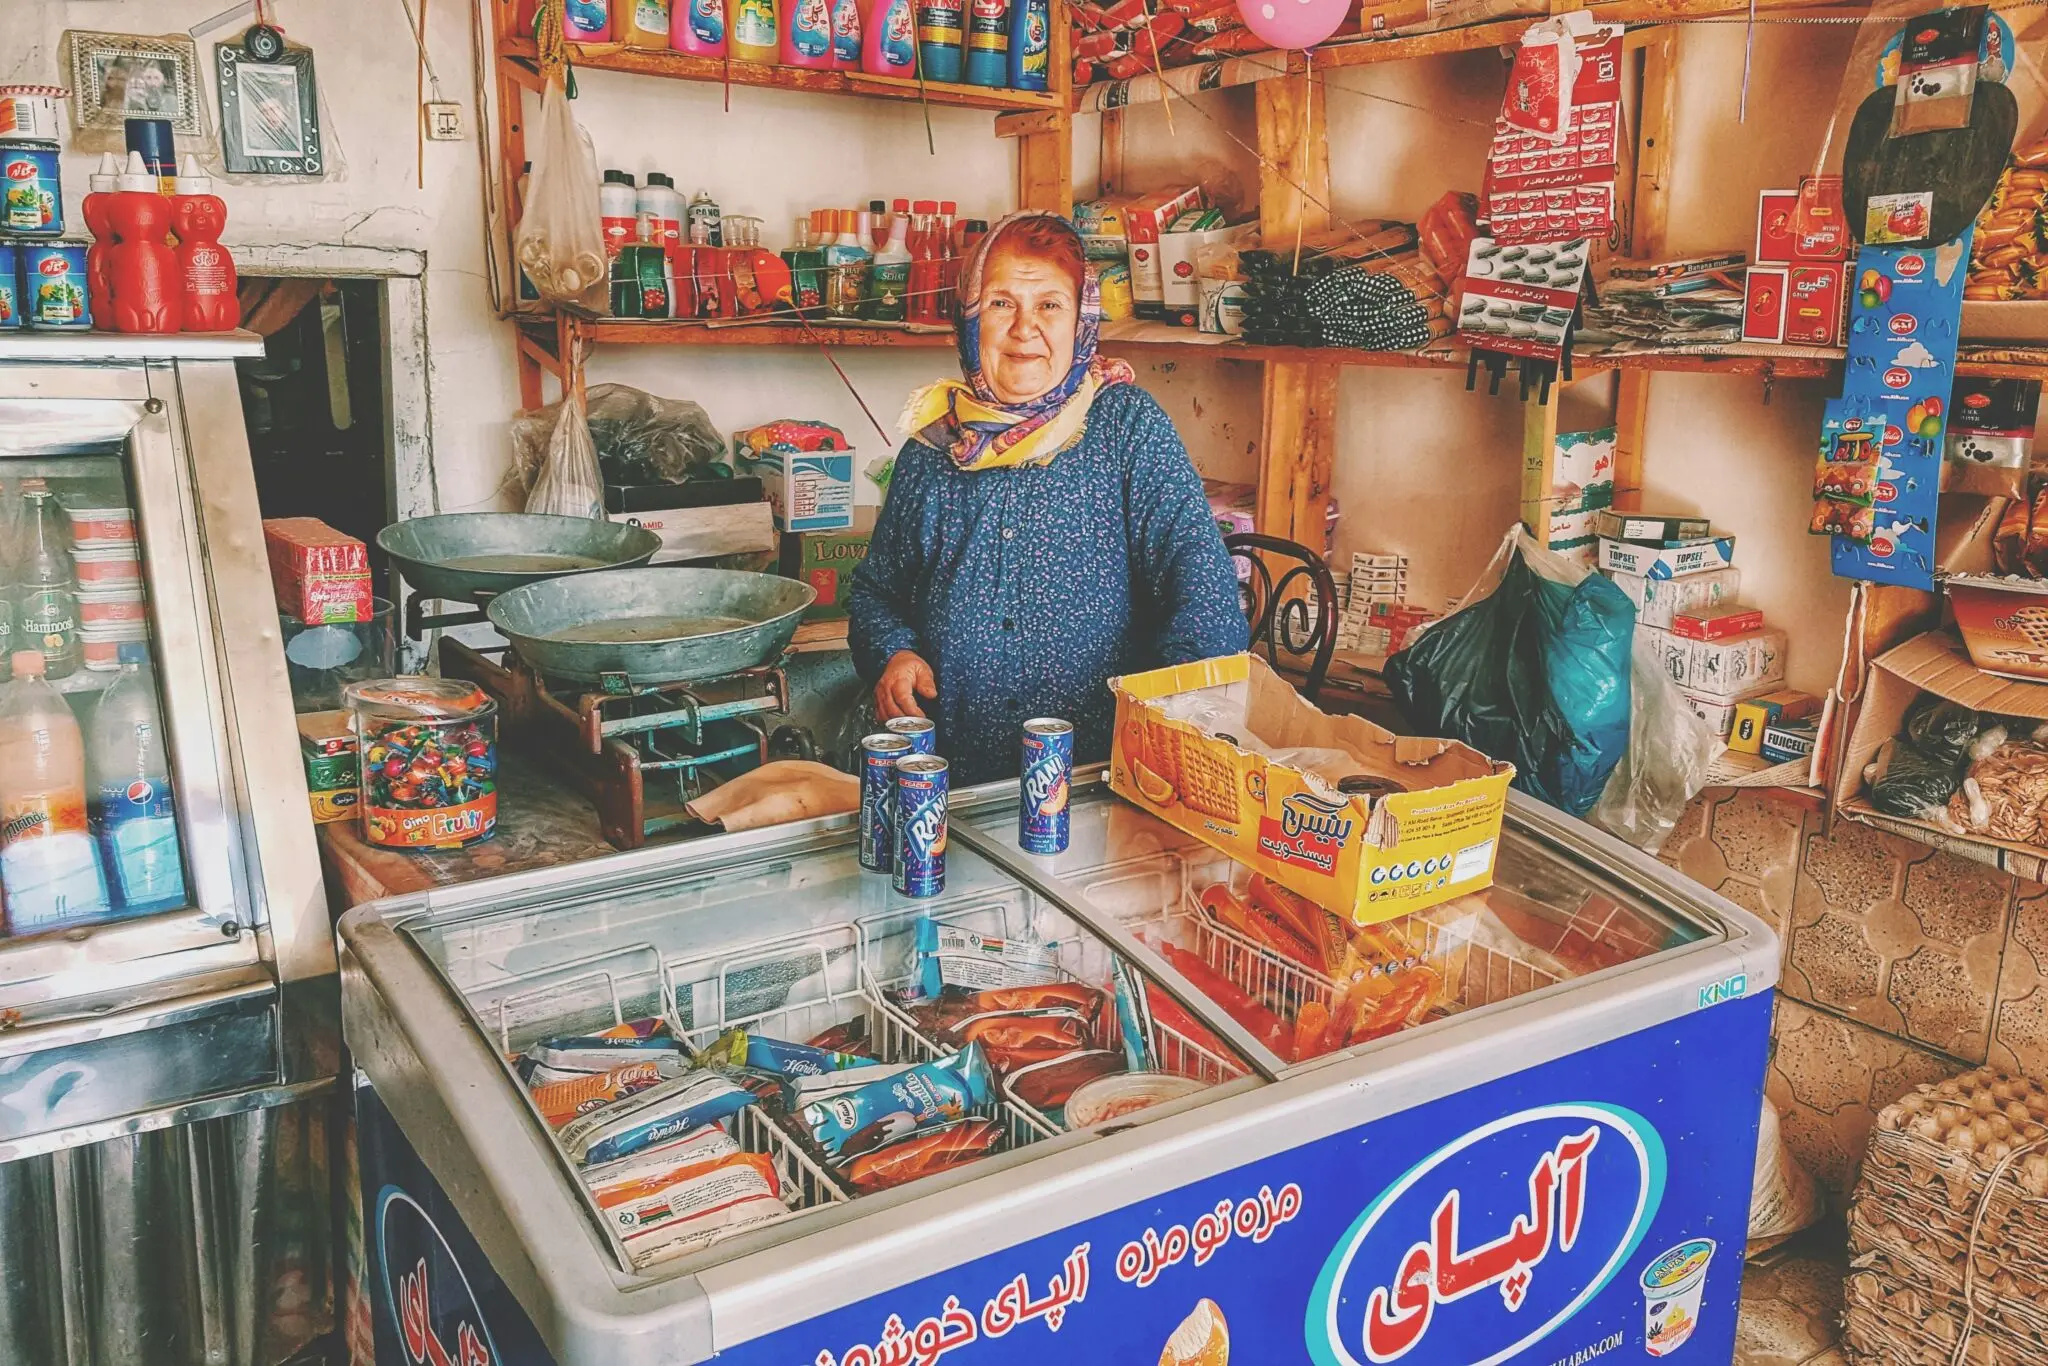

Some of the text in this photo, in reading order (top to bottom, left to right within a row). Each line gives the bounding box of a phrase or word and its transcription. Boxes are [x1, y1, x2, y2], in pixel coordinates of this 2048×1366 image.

[881, 271, 906, 281] SEHAT
[1592, 445, 1617, 478] آهو
[1549, 522, 1571, 533] ضامن
[1767, 733, 1806, 752] FUJICELL
[1026, 756, 1065, 809] RANI
[432, 809, 483, 836] Fruity
[911, 790, 948, 852] RANI
[1260, 836, 1333, 873] بیسکویت
[782, 1059, 823, 1076] Harika
[905, 1072, 938, 1119] Vanilla
[647, 1116, 692, 1143] Harika
[1117, 1183, 1302, 1287] مزه تو مزه
[1363, 1125, 1601, 1364] آلپای
[803, 1242, 1091, 1366] آلپای خوشم
